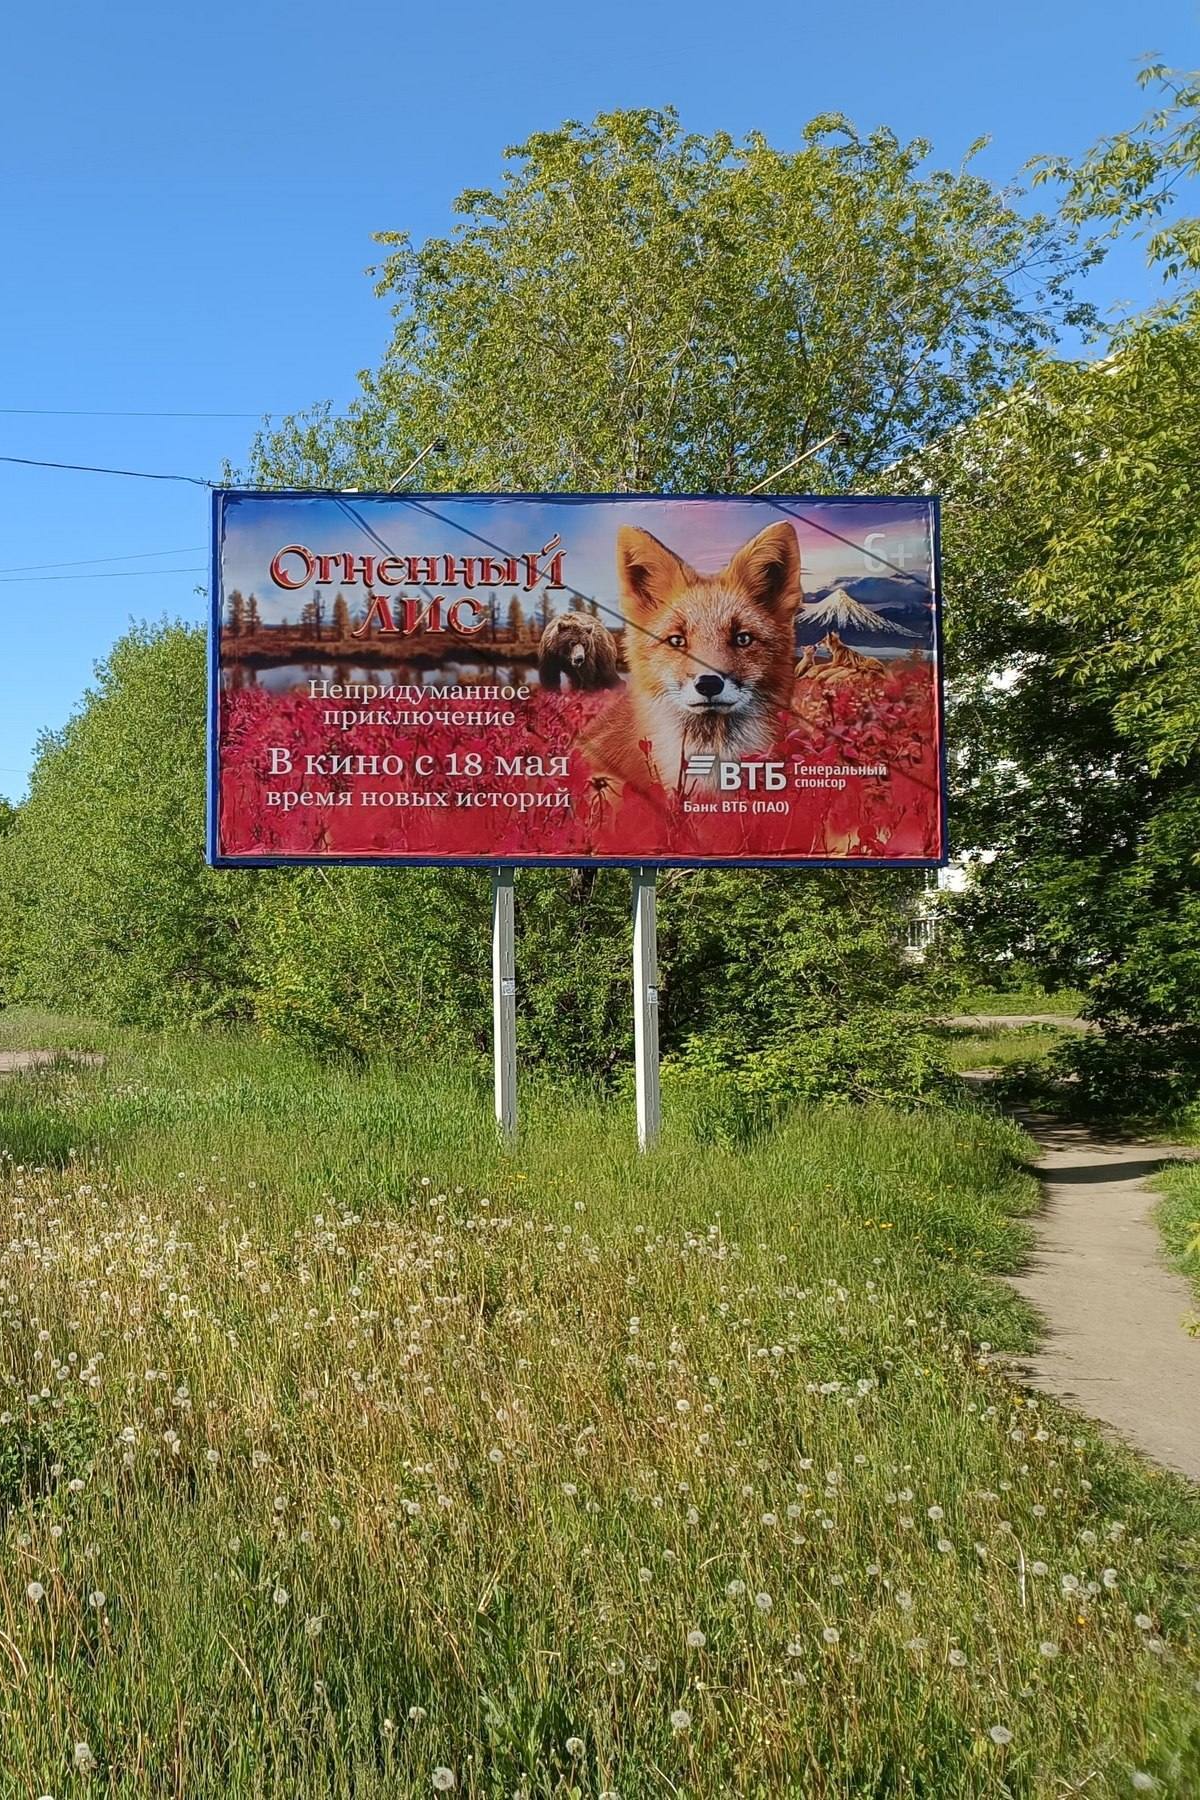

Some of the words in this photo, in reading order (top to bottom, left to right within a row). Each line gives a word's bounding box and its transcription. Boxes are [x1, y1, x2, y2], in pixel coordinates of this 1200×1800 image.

[270, 533, 567, 592] Огненный
[863, 532, 913, 573] 6+
[308, 679, 531, 705] Непридуманное
[323, 708, 516, 730] приключение
[267, 747, 293, 776] В
[304, 753, 404, 776] кино
[415, 753, 435, 776] с
[445, 752, 483, 777] 18
[495, 755, 571, 777] мая
[794, 761, 887, 777] Генеральный
[720, 761, 787, 791] ВТБ
[794, 779, 847, 790] спонсор
[266, 790, 353, 811] время
[361, 790, 449, 808] новых
[455, 787, 571, 813] историй
[683, 801, 718, 813] Банк
[722, 801, 748, 813] ВТБ
[752, 801, 790, 815] (ПАО)
